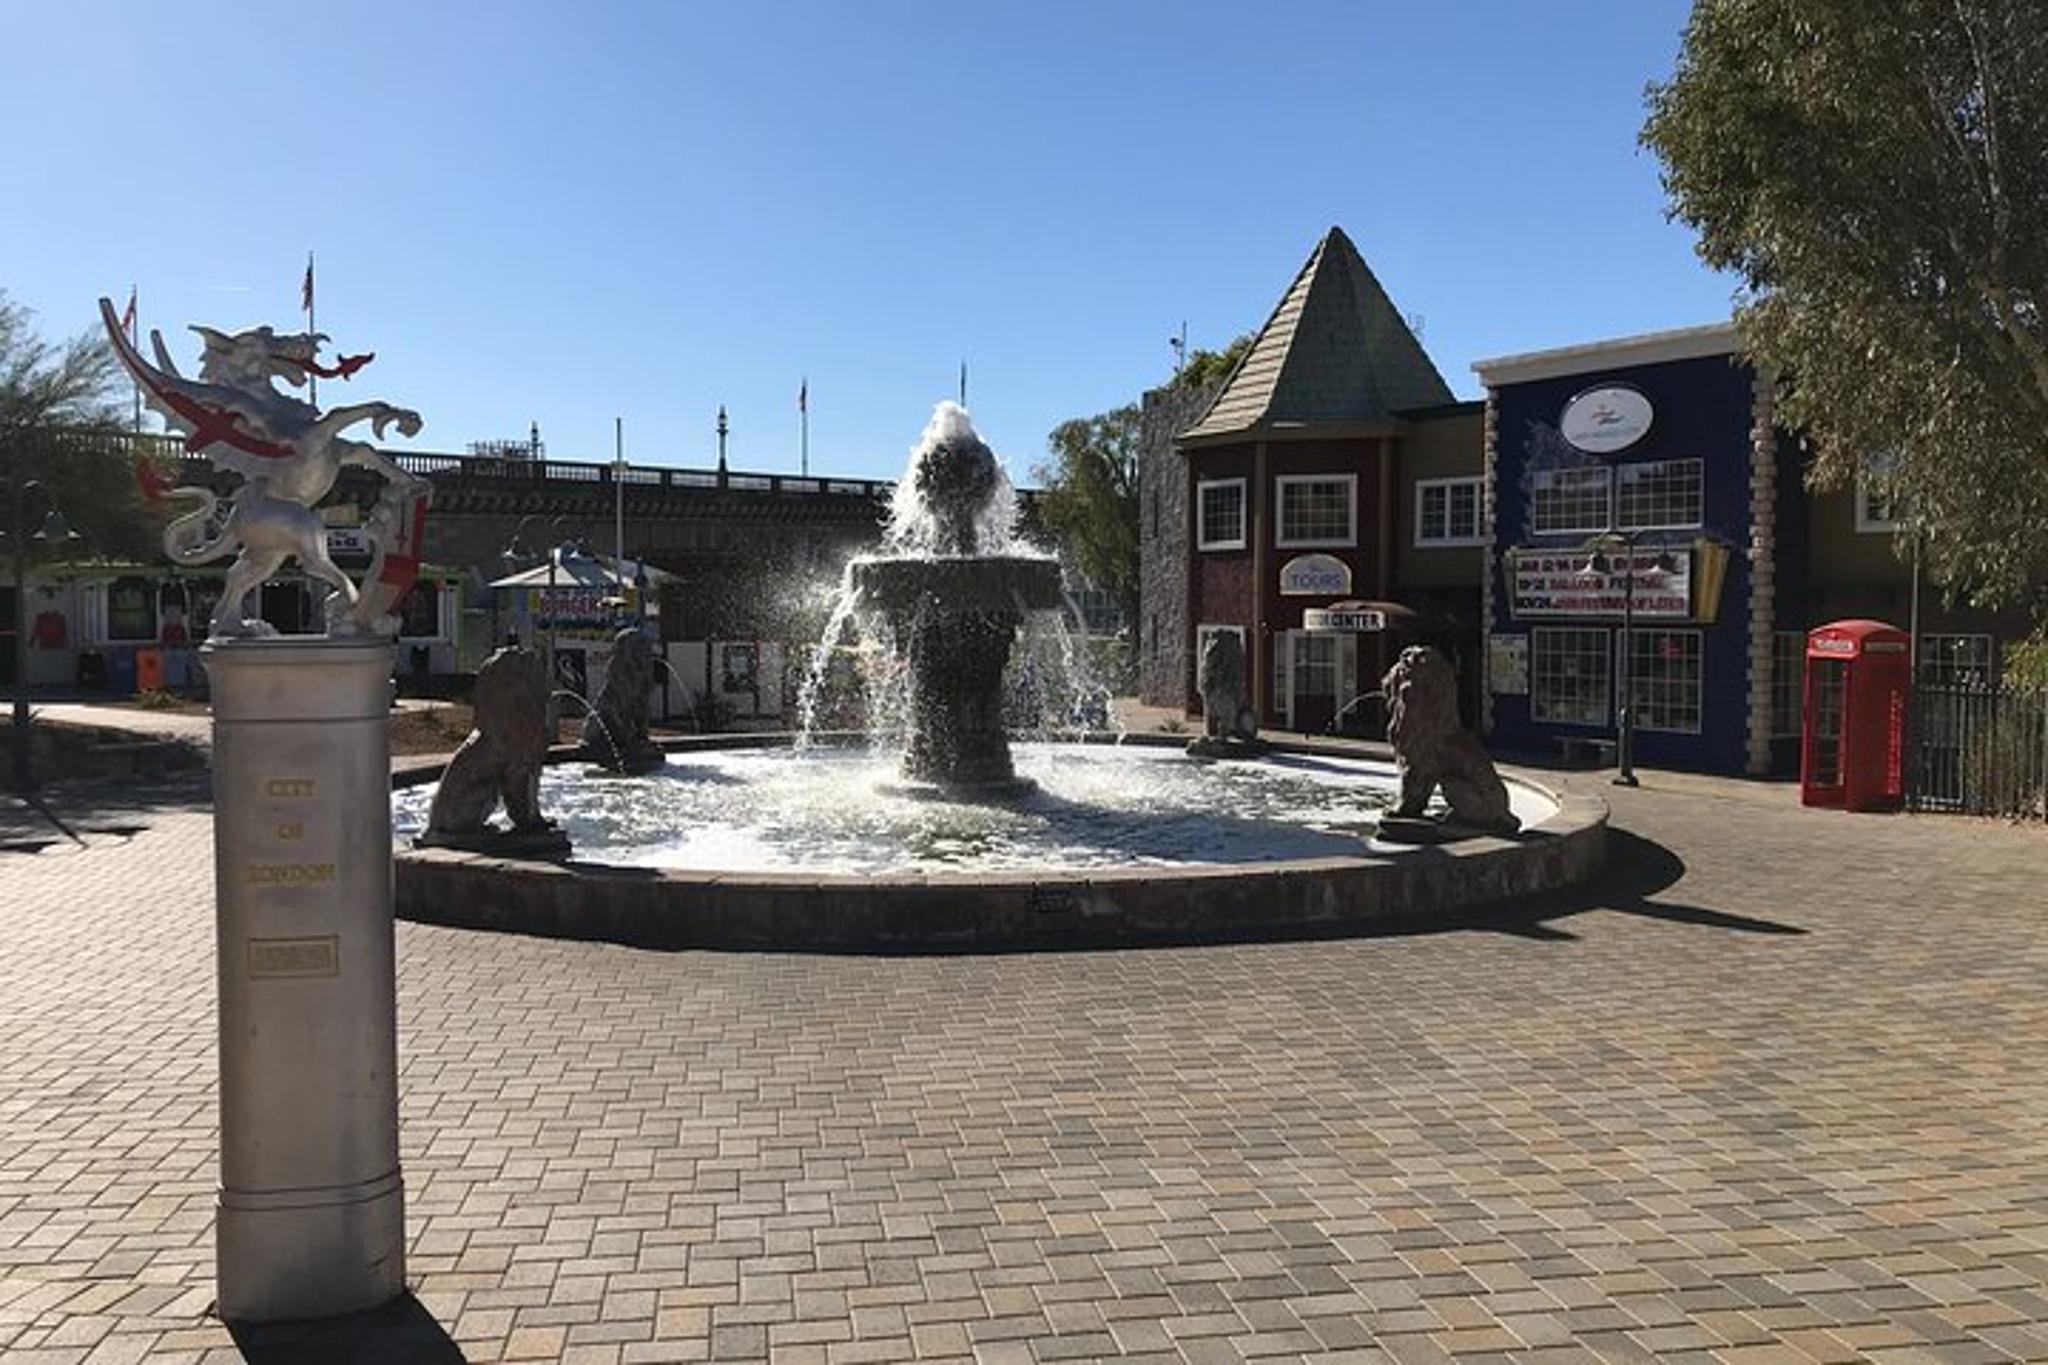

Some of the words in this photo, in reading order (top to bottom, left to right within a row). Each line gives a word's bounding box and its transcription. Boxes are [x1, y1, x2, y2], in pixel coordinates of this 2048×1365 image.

[1292, 573, 1341, 589] TOURS
[1330, 613, 1379, 629] CENTER
[269, 778, 315, 797] CITY
[277, 822, 304, 840] OF
[249, 864, 337, 883] LONDON
